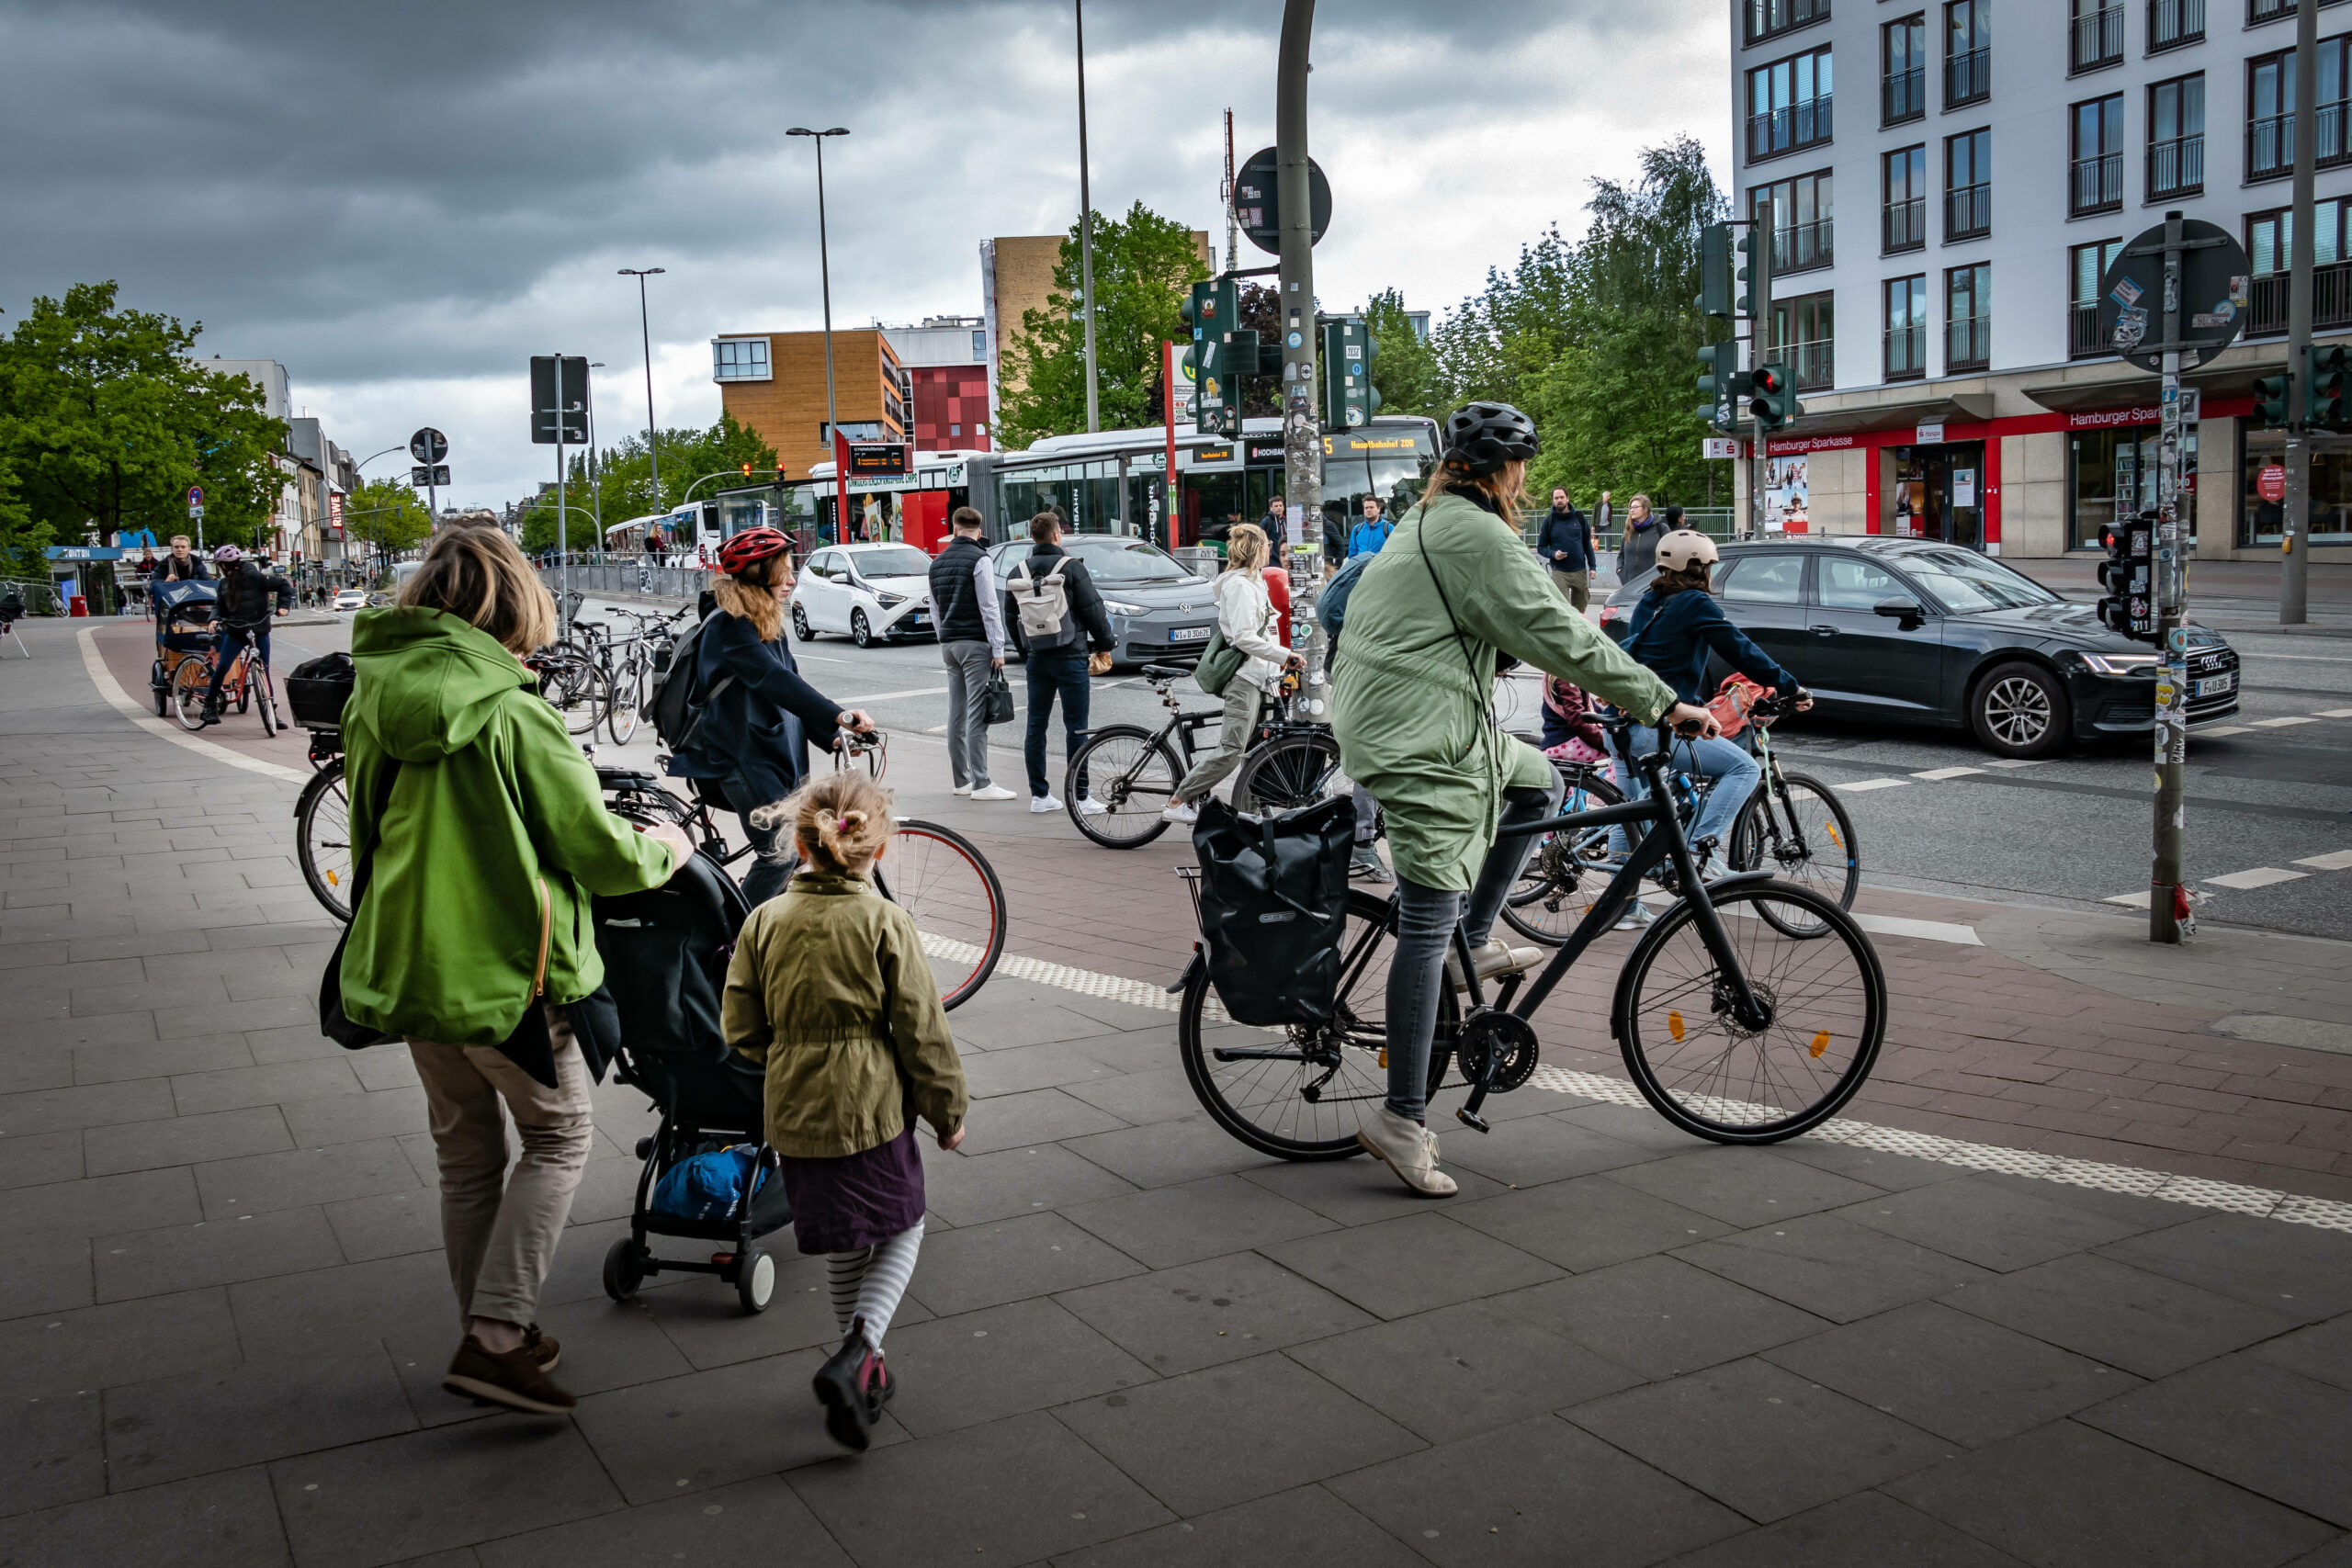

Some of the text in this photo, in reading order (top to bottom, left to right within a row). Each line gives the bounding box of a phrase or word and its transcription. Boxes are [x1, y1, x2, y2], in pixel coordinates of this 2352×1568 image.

[2070, 412, 2131, 426] Hamburger
[1323, 437, 1333, 455] 5
[1351, 439, 1398, 449] Hauptbahnhof
[1770, 436, 1853, 452] Hamburger Sparkasse
[330, 495, 342, 527] REWE
